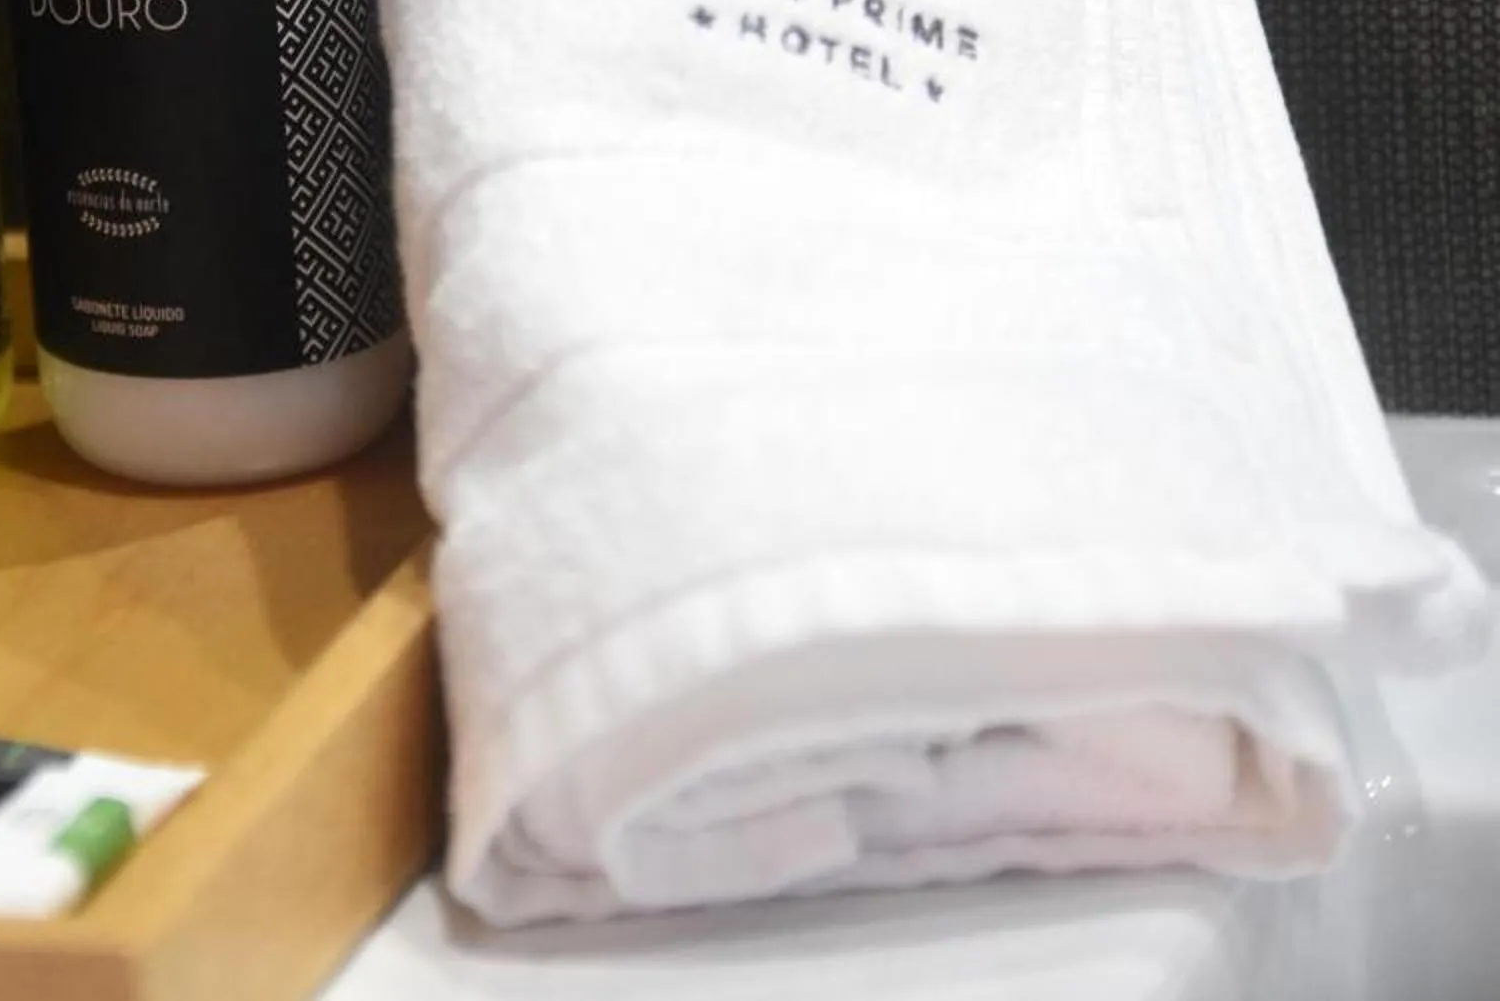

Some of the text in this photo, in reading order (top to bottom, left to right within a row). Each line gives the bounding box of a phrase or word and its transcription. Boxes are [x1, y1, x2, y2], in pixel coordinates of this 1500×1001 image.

[739, 12, 903, 91] HOTEL
[70, 296, 130, 320] SABONETE
[127, 323, 160, 338] SOAP
